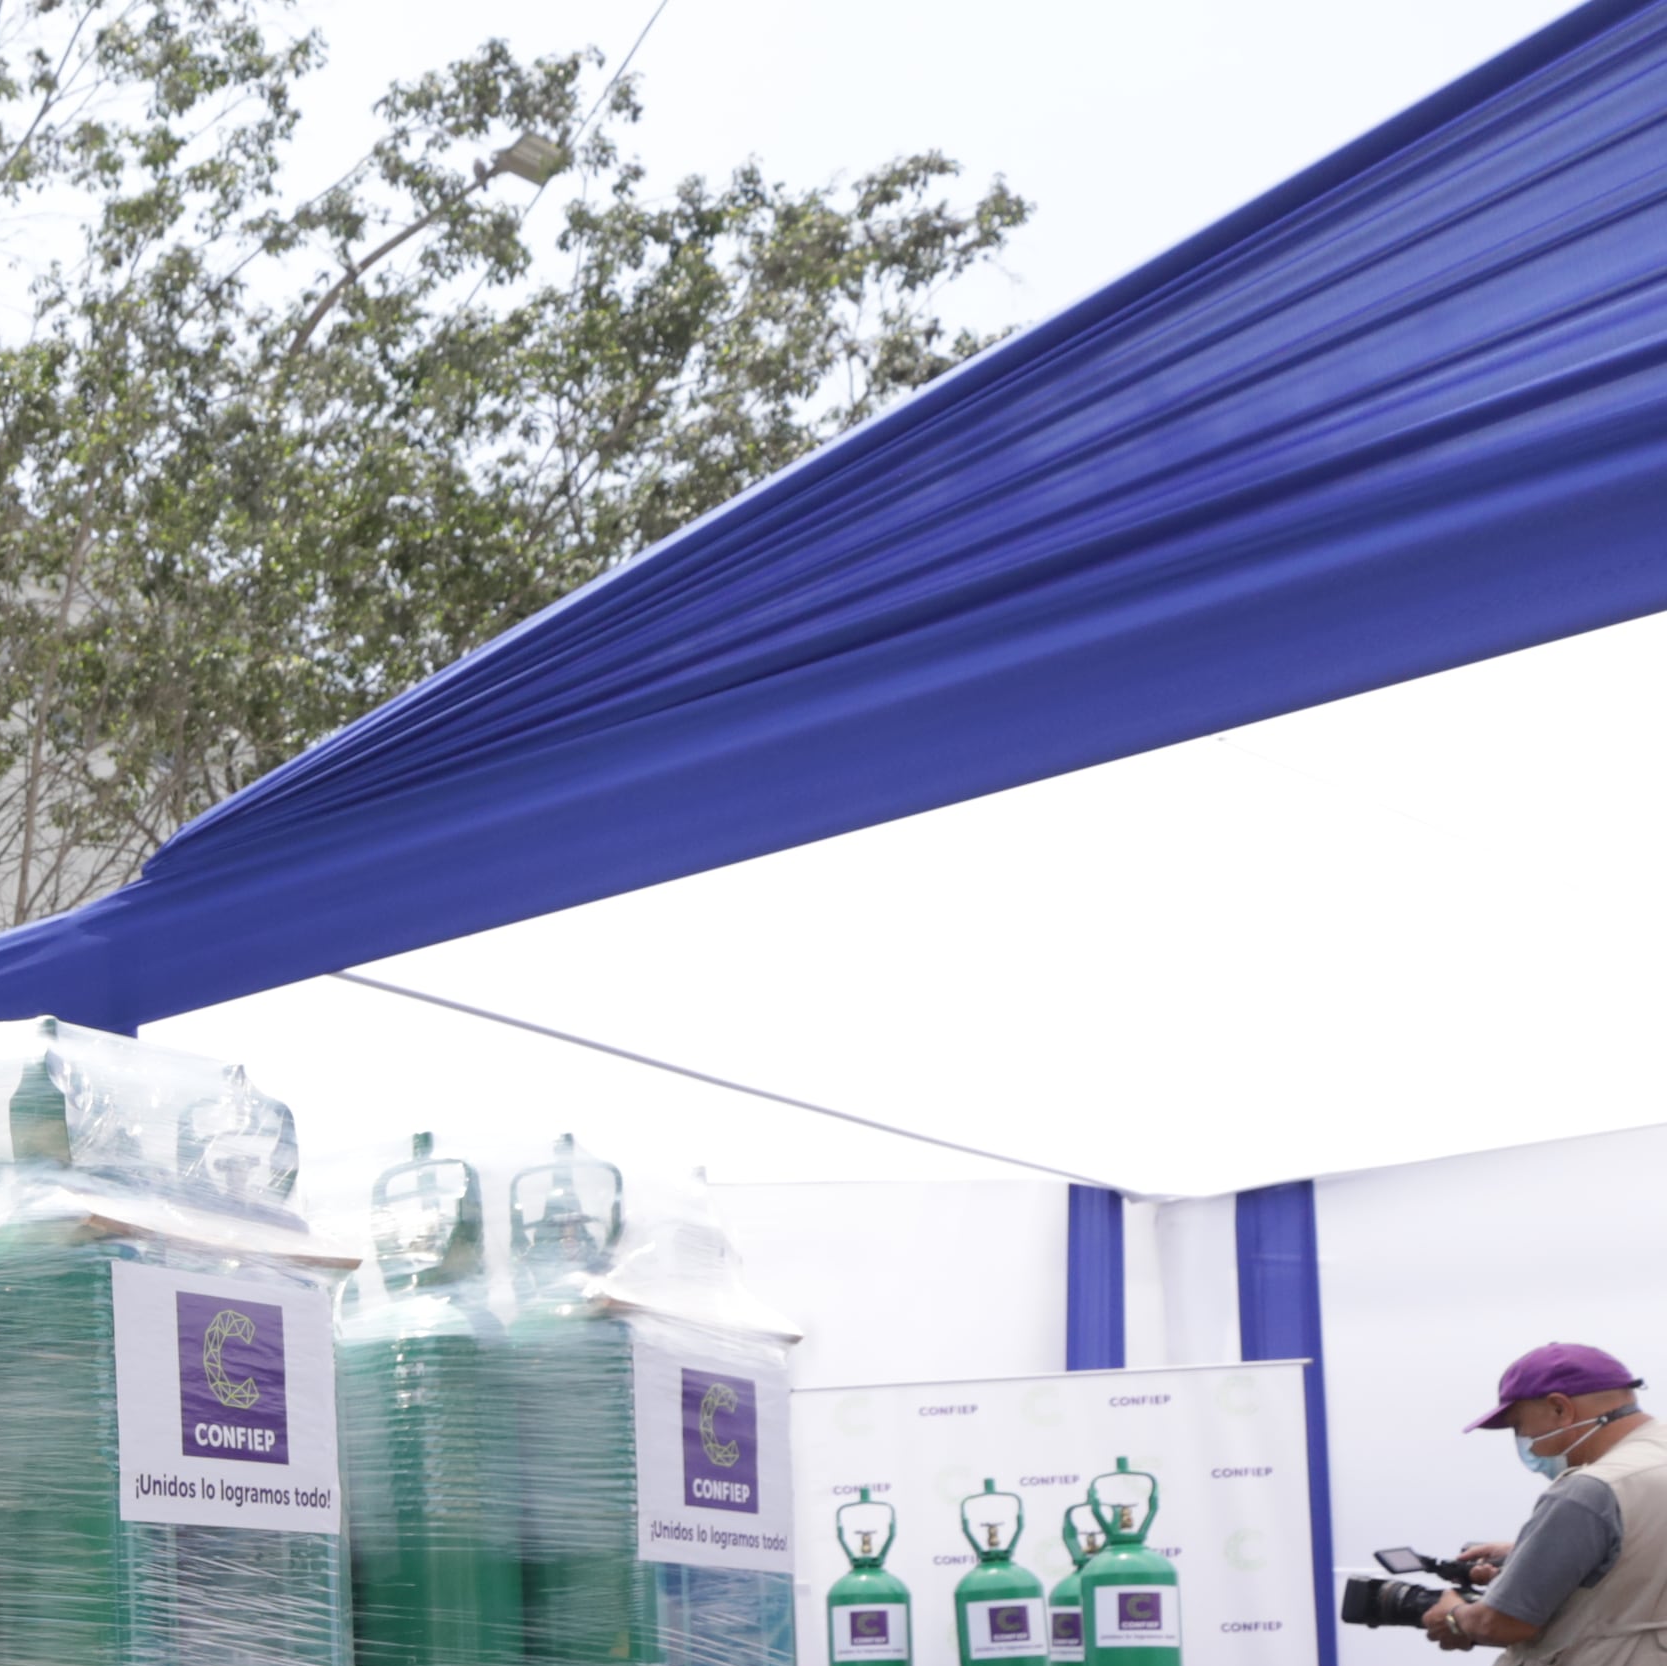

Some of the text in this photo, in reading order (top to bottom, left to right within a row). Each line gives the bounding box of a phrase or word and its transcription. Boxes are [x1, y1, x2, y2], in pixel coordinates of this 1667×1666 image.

[1109, 1394, 1171, 1407] CONFIEP
[919, 1405, 978, 1416] CONFIEP
[195, 1422, 275, 1452] CONFIEP
[1211, 1467, 1273, 1479] CONFIEP
[1020, 1475, 1080, 1486] CONFIEP
[135, 1474, 331, 1509] ¡Unidos lo logramos todo!
[693, 1478, 750, 1503] CONFIEP
[651, 1520, 787, 1551] ¡Unidos lo logramos todo!
[933, 1555, 975, 1566] CONFI
[1220, 1621, 1283, 1633] CONFIEP
